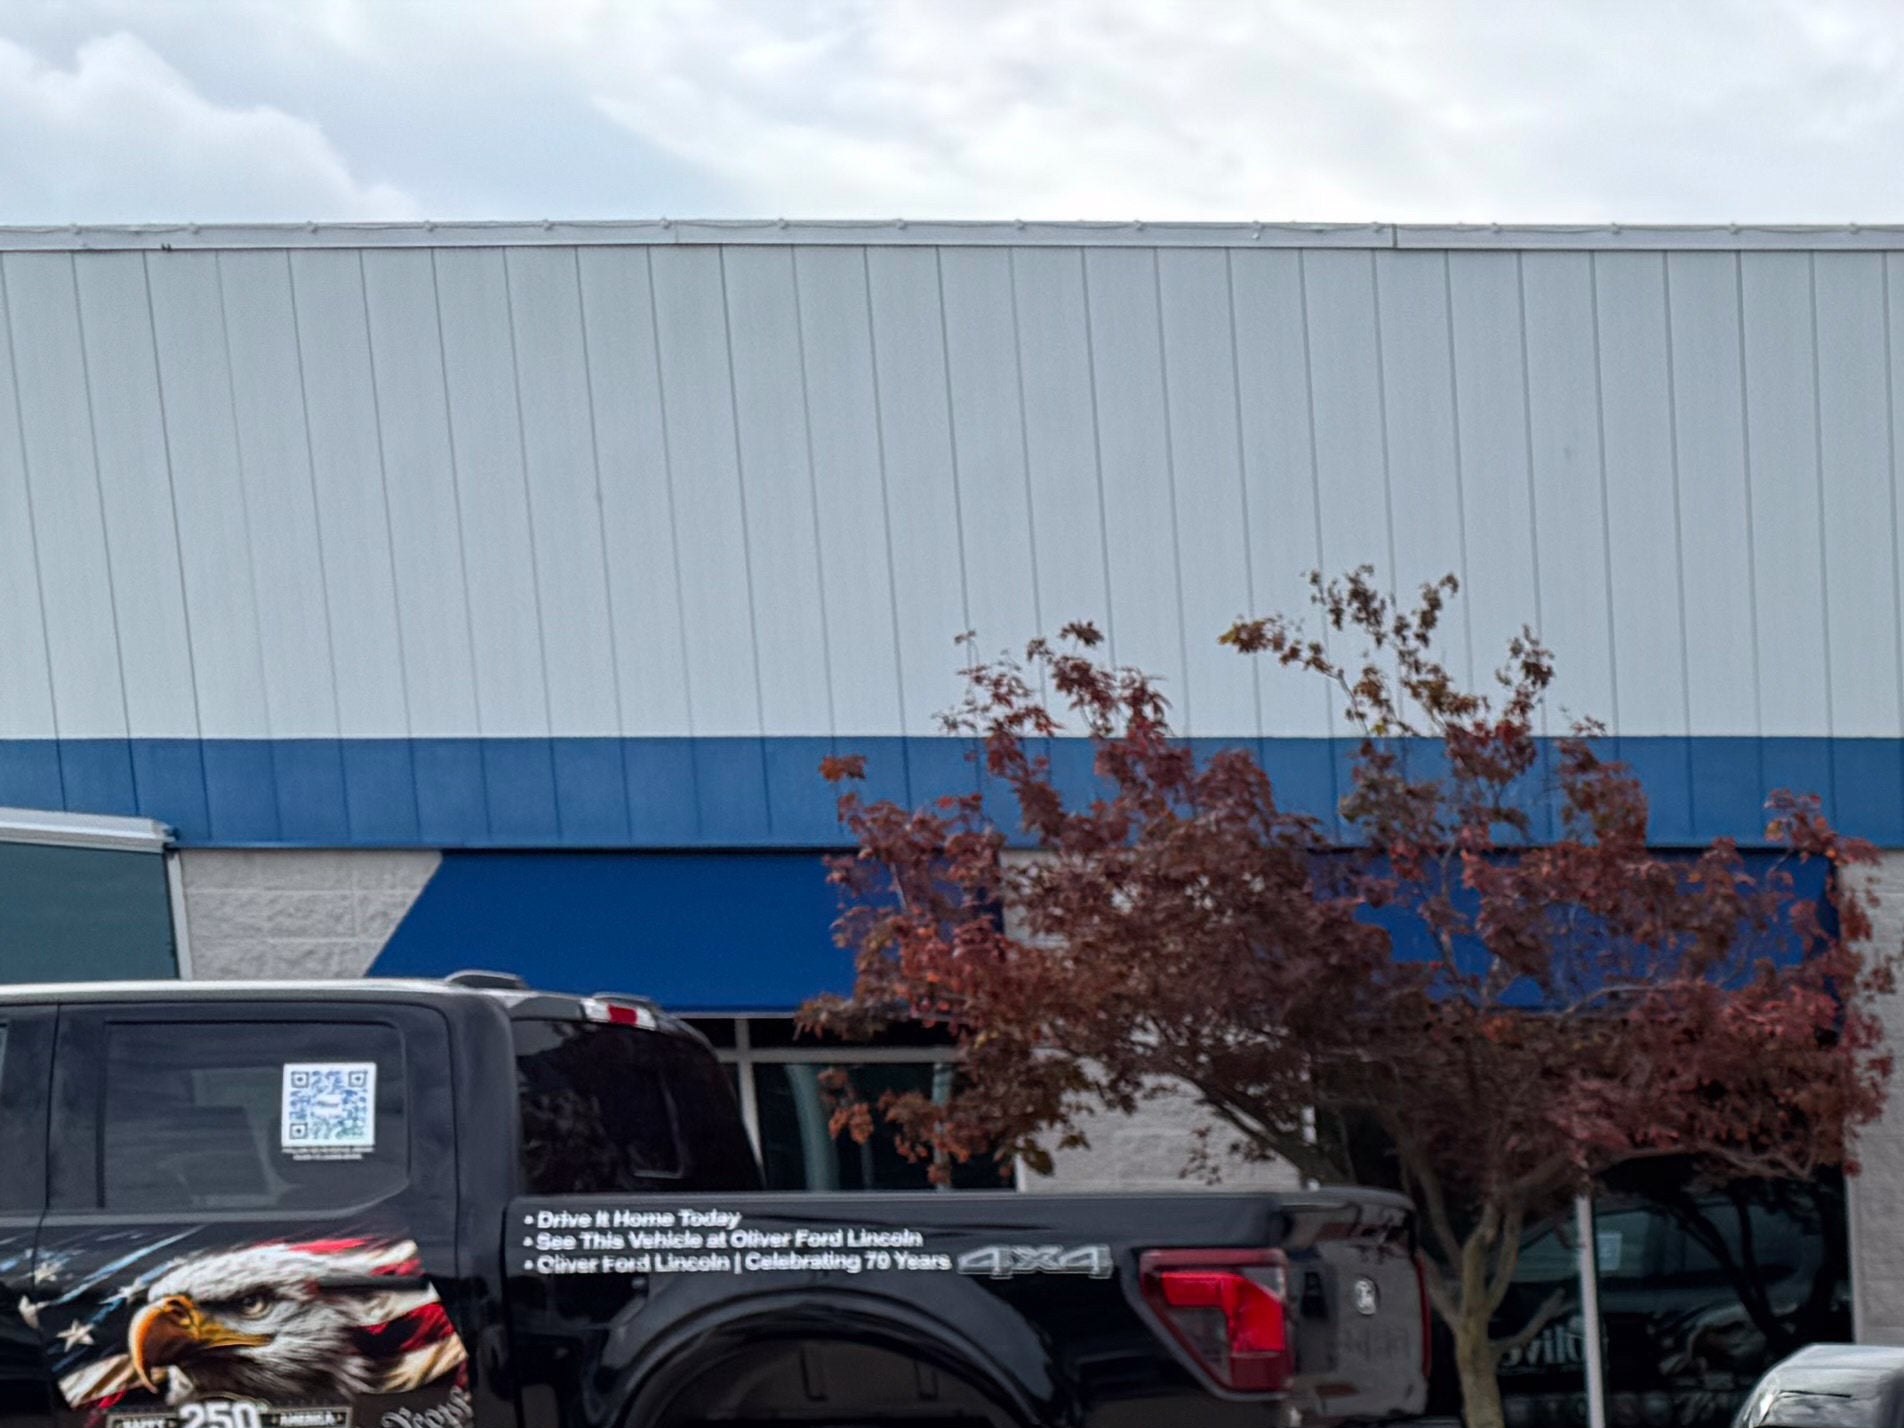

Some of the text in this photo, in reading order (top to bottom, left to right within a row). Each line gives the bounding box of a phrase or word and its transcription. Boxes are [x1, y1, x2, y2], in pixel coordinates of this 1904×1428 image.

[536, 1208, 742, 1230] Drive It Home Today
[535, 1228, 923, 1250] See This Vehicle at Oliver Ford Lincoln
[536, 1253, 599, 1274] Oliver
[602, 1252, 650, 1273] Ford
[654, 1252, 731, 1272] Lincoln
[745, 1251, 862, 1274] Celebrating
[864, 1250, 891, 1269] 70
[893, 1251, 953, 1271] Years
